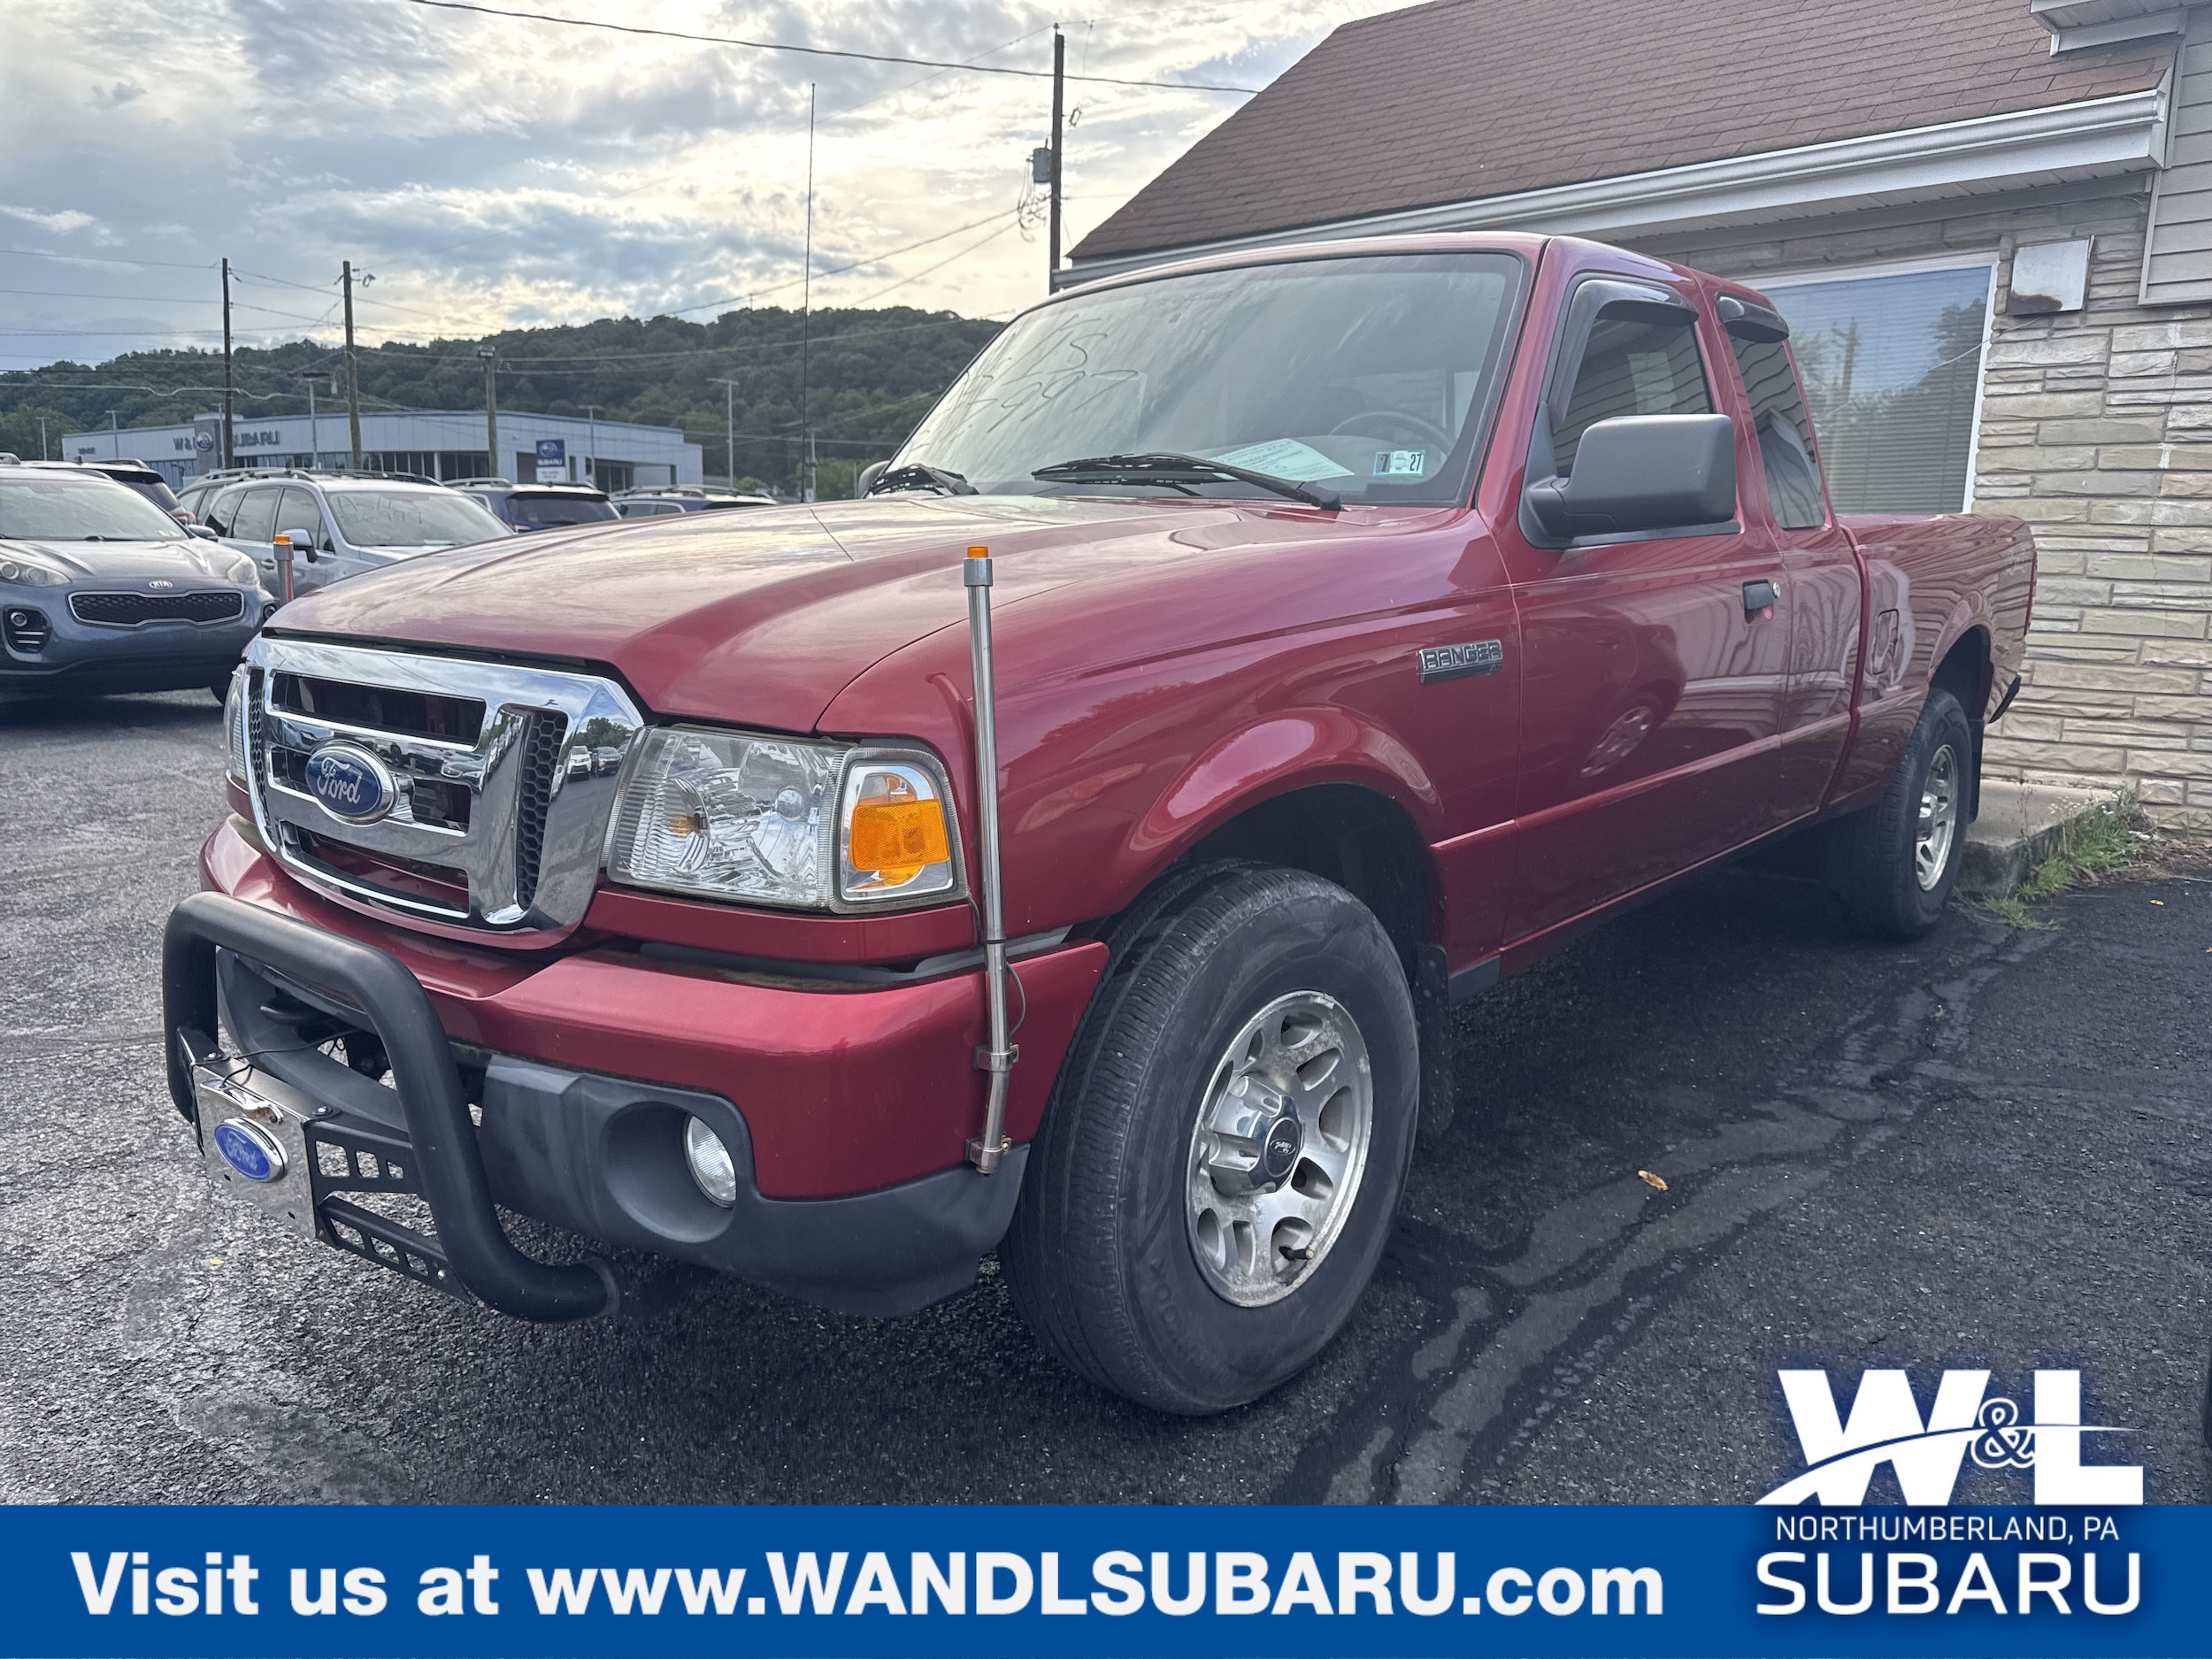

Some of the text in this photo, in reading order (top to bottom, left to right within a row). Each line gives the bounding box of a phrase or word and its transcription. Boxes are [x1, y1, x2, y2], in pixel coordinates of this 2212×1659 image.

[231, 430, 280, 449] UBARU
[1409, 453, 1422, 472] 27
[150, 580, 171, 589] KIA
[1421, 641, 1502, 670] RANGER
[317, 757, 363, 804] Ford
[226, 1131, 258, 1171] Ford
